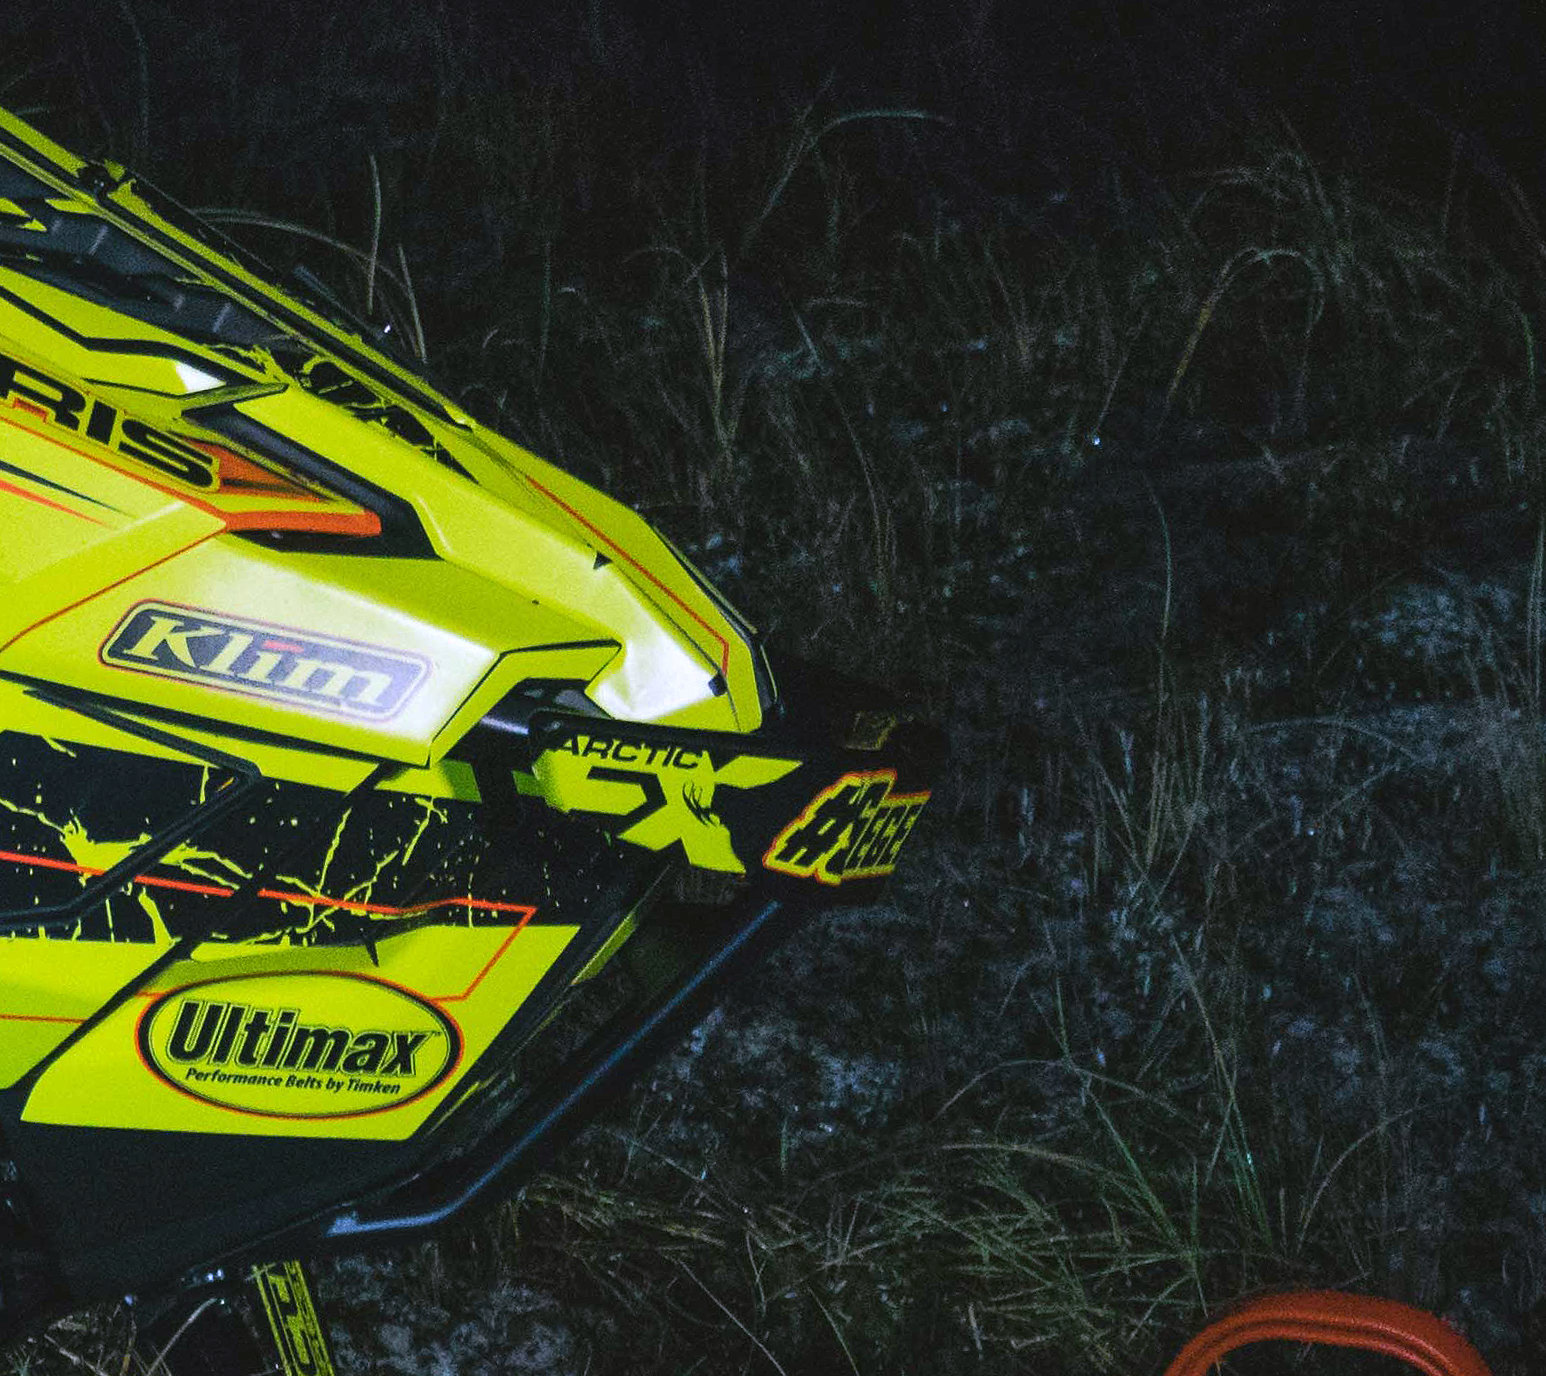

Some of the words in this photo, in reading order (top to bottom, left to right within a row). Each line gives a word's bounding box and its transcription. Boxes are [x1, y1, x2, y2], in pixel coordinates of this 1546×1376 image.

[123, 616, 393, 705] Klim
[168, 1001, 429, 1076] Ultimax
[186, 1068, 281, 1086] Performance
[286, 1074, 322, 1089] Belts
[326, 1079, 343, 1092] by
[347, 1078, 400, 1094] Timken
